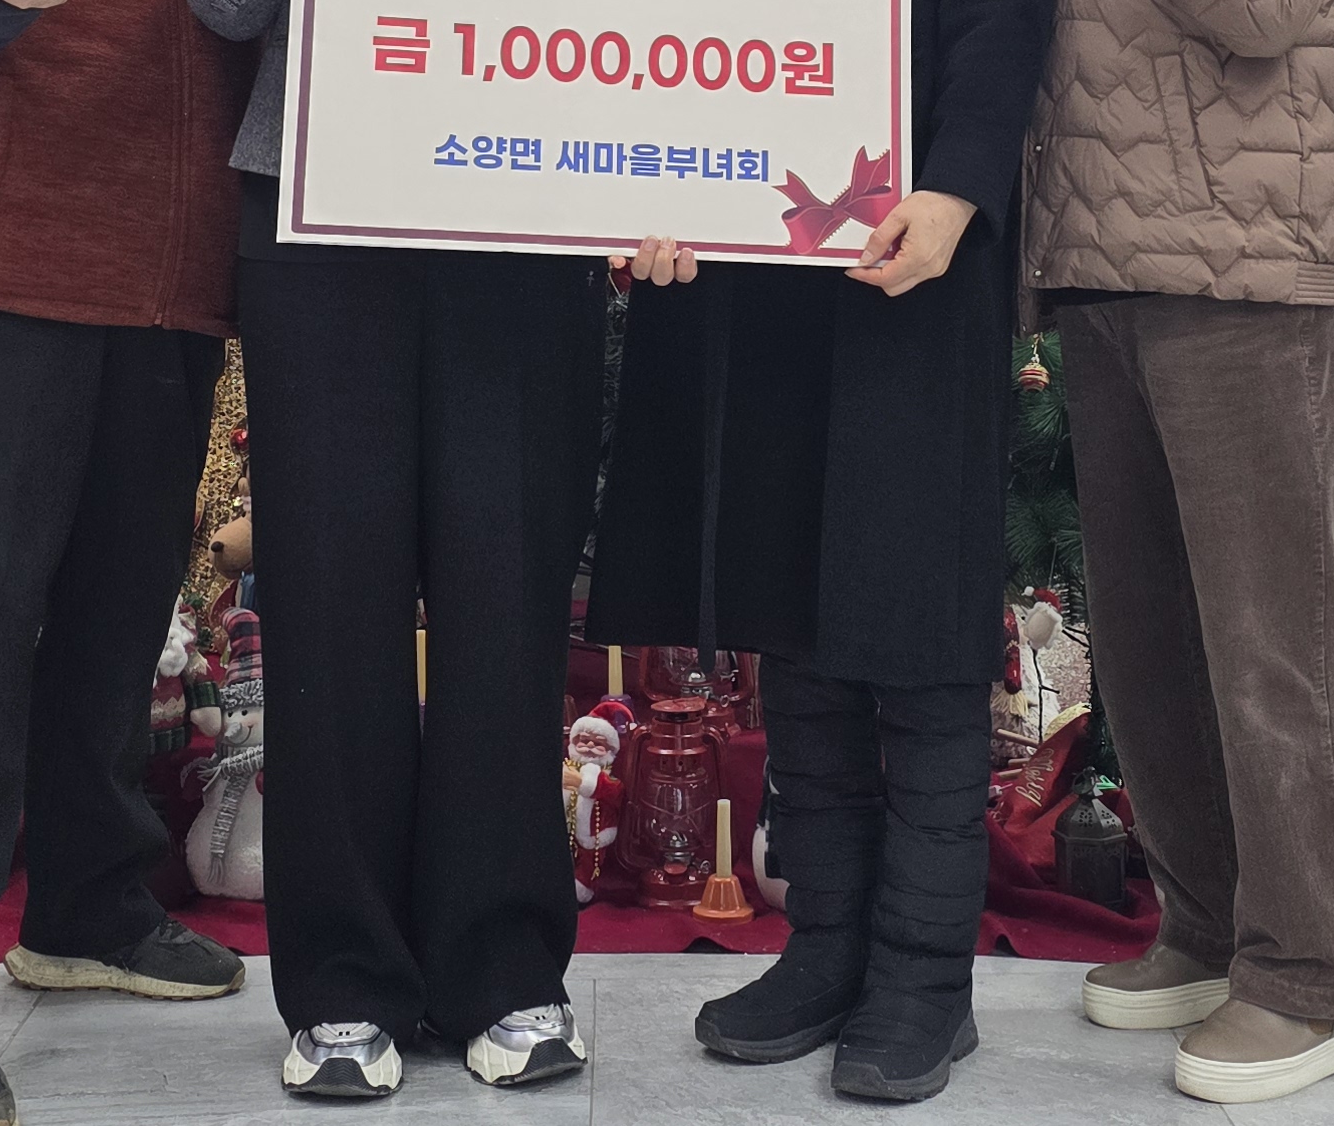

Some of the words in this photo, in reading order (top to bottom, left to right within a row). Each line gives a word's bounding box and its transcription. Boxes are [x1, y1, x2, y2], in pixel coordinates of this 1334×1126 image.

[372, 16, 431, 74] 금
[453, 23, 835, 97] 1,000,000원
[433, 134, 543, 172] 소양면
[555, 141, 769, 183] 새마을부녀회
